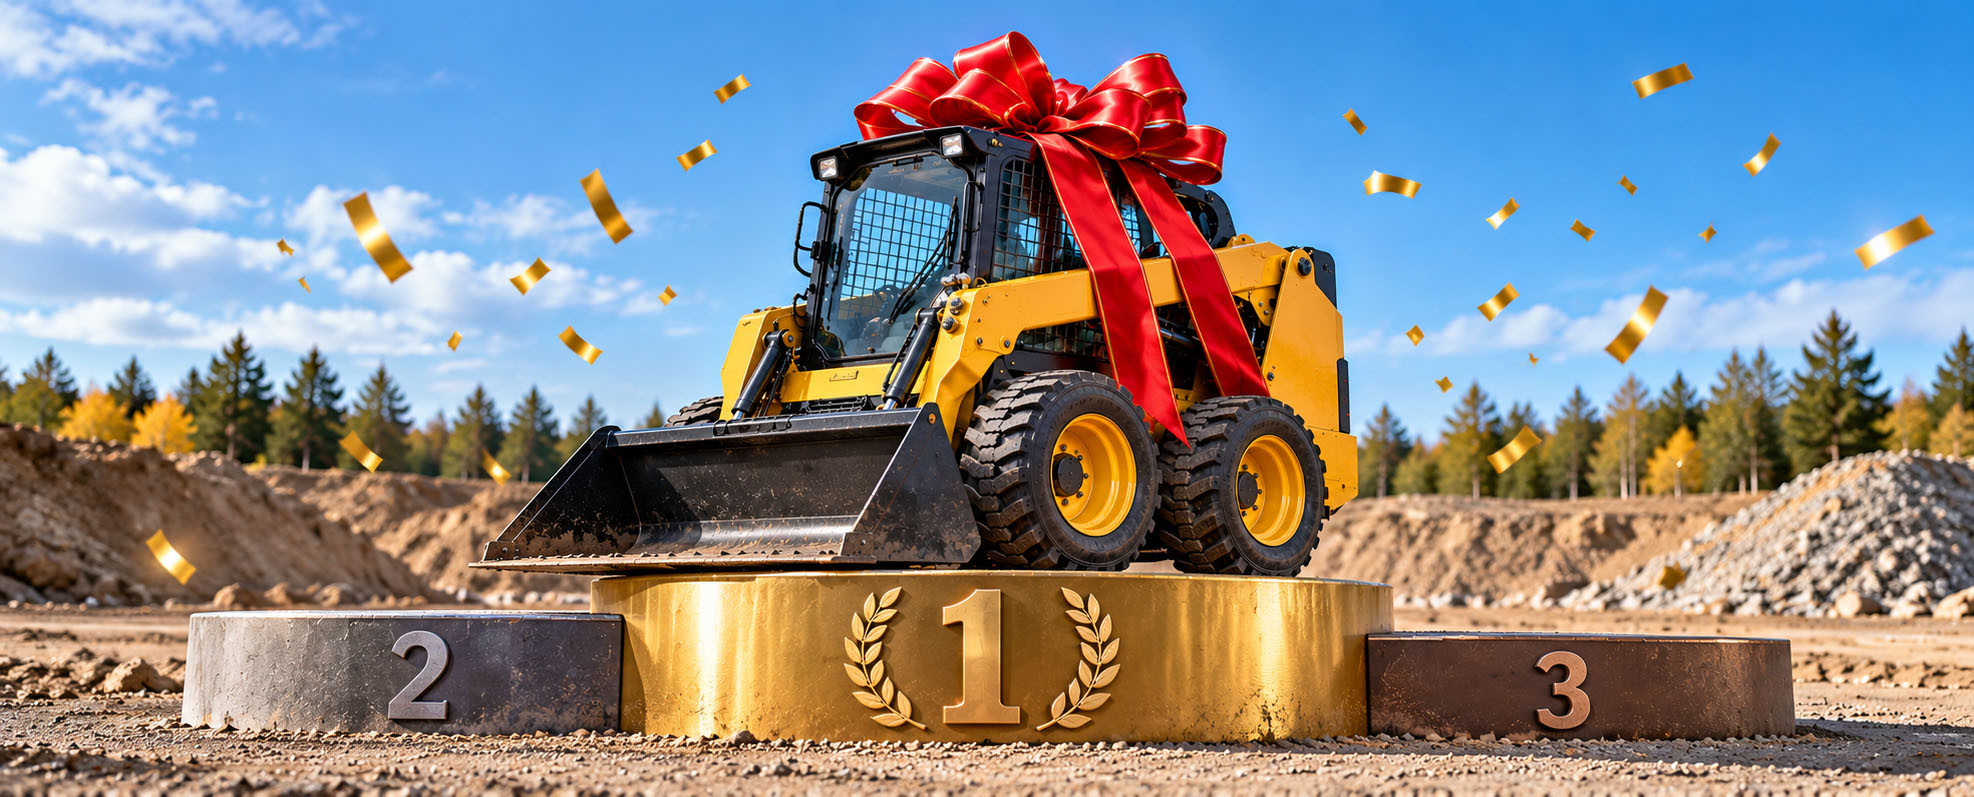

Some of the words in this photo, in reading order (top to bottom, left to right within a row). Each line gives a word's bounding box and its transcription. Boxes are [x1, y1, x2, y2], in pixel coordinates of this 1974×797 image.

[388, 630, 448, 719] 2
[943, 589, 1020, 724] 1
[1535, 650, 1591, 729] 3
